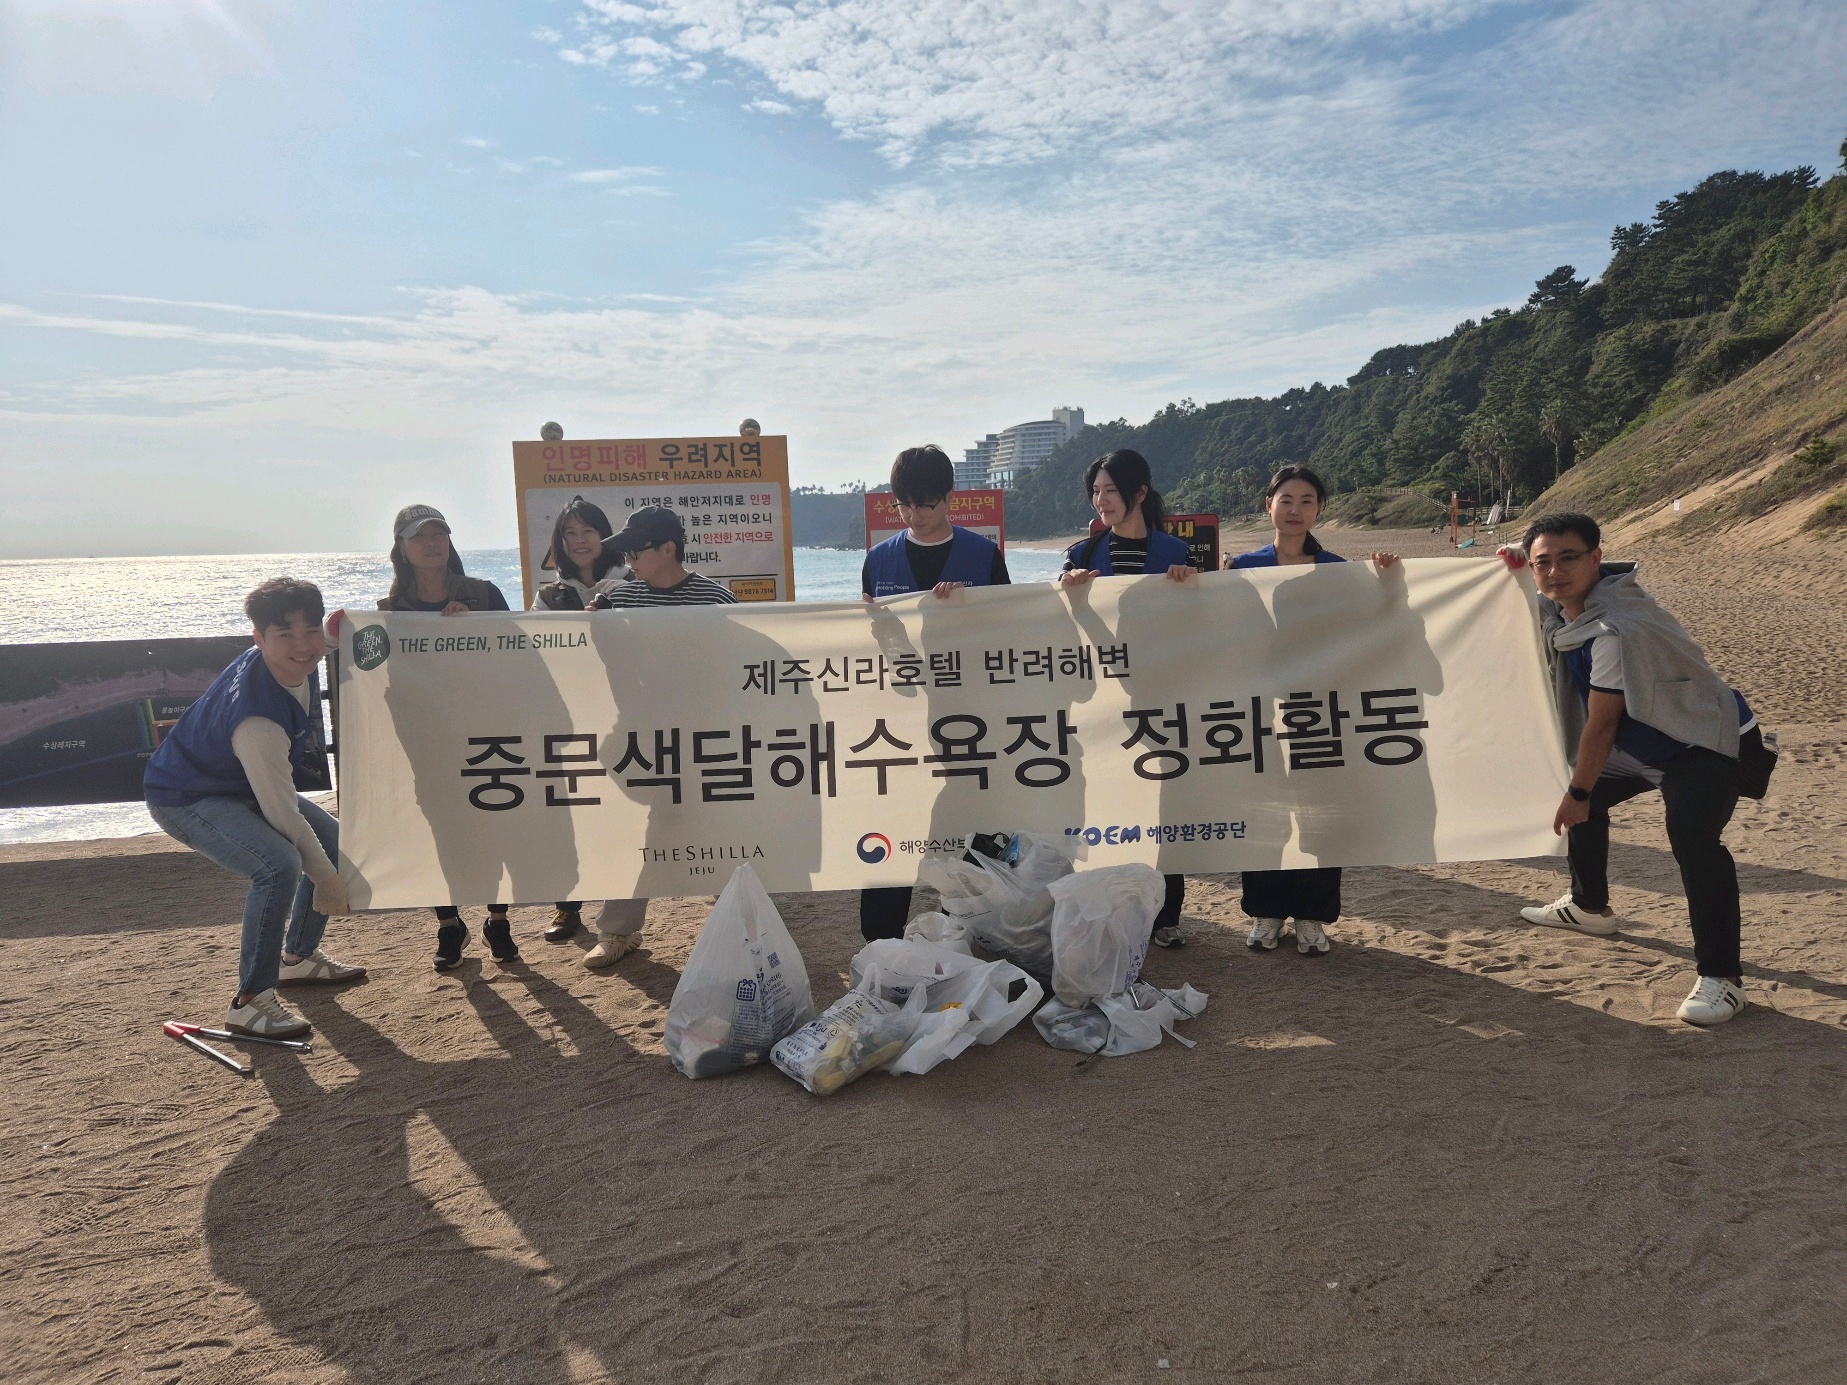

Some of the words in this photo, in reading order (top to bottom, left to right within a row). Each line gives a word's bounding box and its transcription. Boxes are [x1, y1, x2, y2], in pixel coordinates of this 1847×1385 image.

[542, 444, 648, 472] 인명피해
[659, 441, 762, 469] 우려지역
[543, 472, 606, 484] (NATURAL
[609, 471, 669, 482] DISASTER
[673, 470, 722, 480] HAZARD
[726, 468, 762, 479] AREA)
[624, 498, 634, 509] 이
[640, 496, 673, 508] 지역은
[678, 495, 745, 508] 해안저지대로
[750, 493, 771, 506] 인명
[949, 495, 995, 511] 금지구역
[690, 514, 713, 526] 높은
[717, 512, 772, 525] 지역이오니
[946, 513, 984, 522] OHIBITED)
[692, 533, 701, 545] 시
[703, 533, 733, 545] 안전한
[735, 531, 774, 544] 지역으로
[399, 638, 428, 653] THE
[434, 636, 491, 653] GREEN,
[497, 634, 526, 650] THE
[532, 632, 588, 650] SHILLA
[742, 650, 962, 696] 제주신라호텔
[984, 643, 1130, 684] 반려해변
[161, 705, 190, 715] 물놀이구
[42, 739, 86, 750] 수상레저구역
[460, 709, 1078, 811] 중문색달해수욕장
[1121, 688, 1429, 781] 정화활동
[1146, 820, 1247, 845] 해양환경공단
[899, 837, 966, 855] 해양수산부
[689, 866, 715, 876] JEJU
